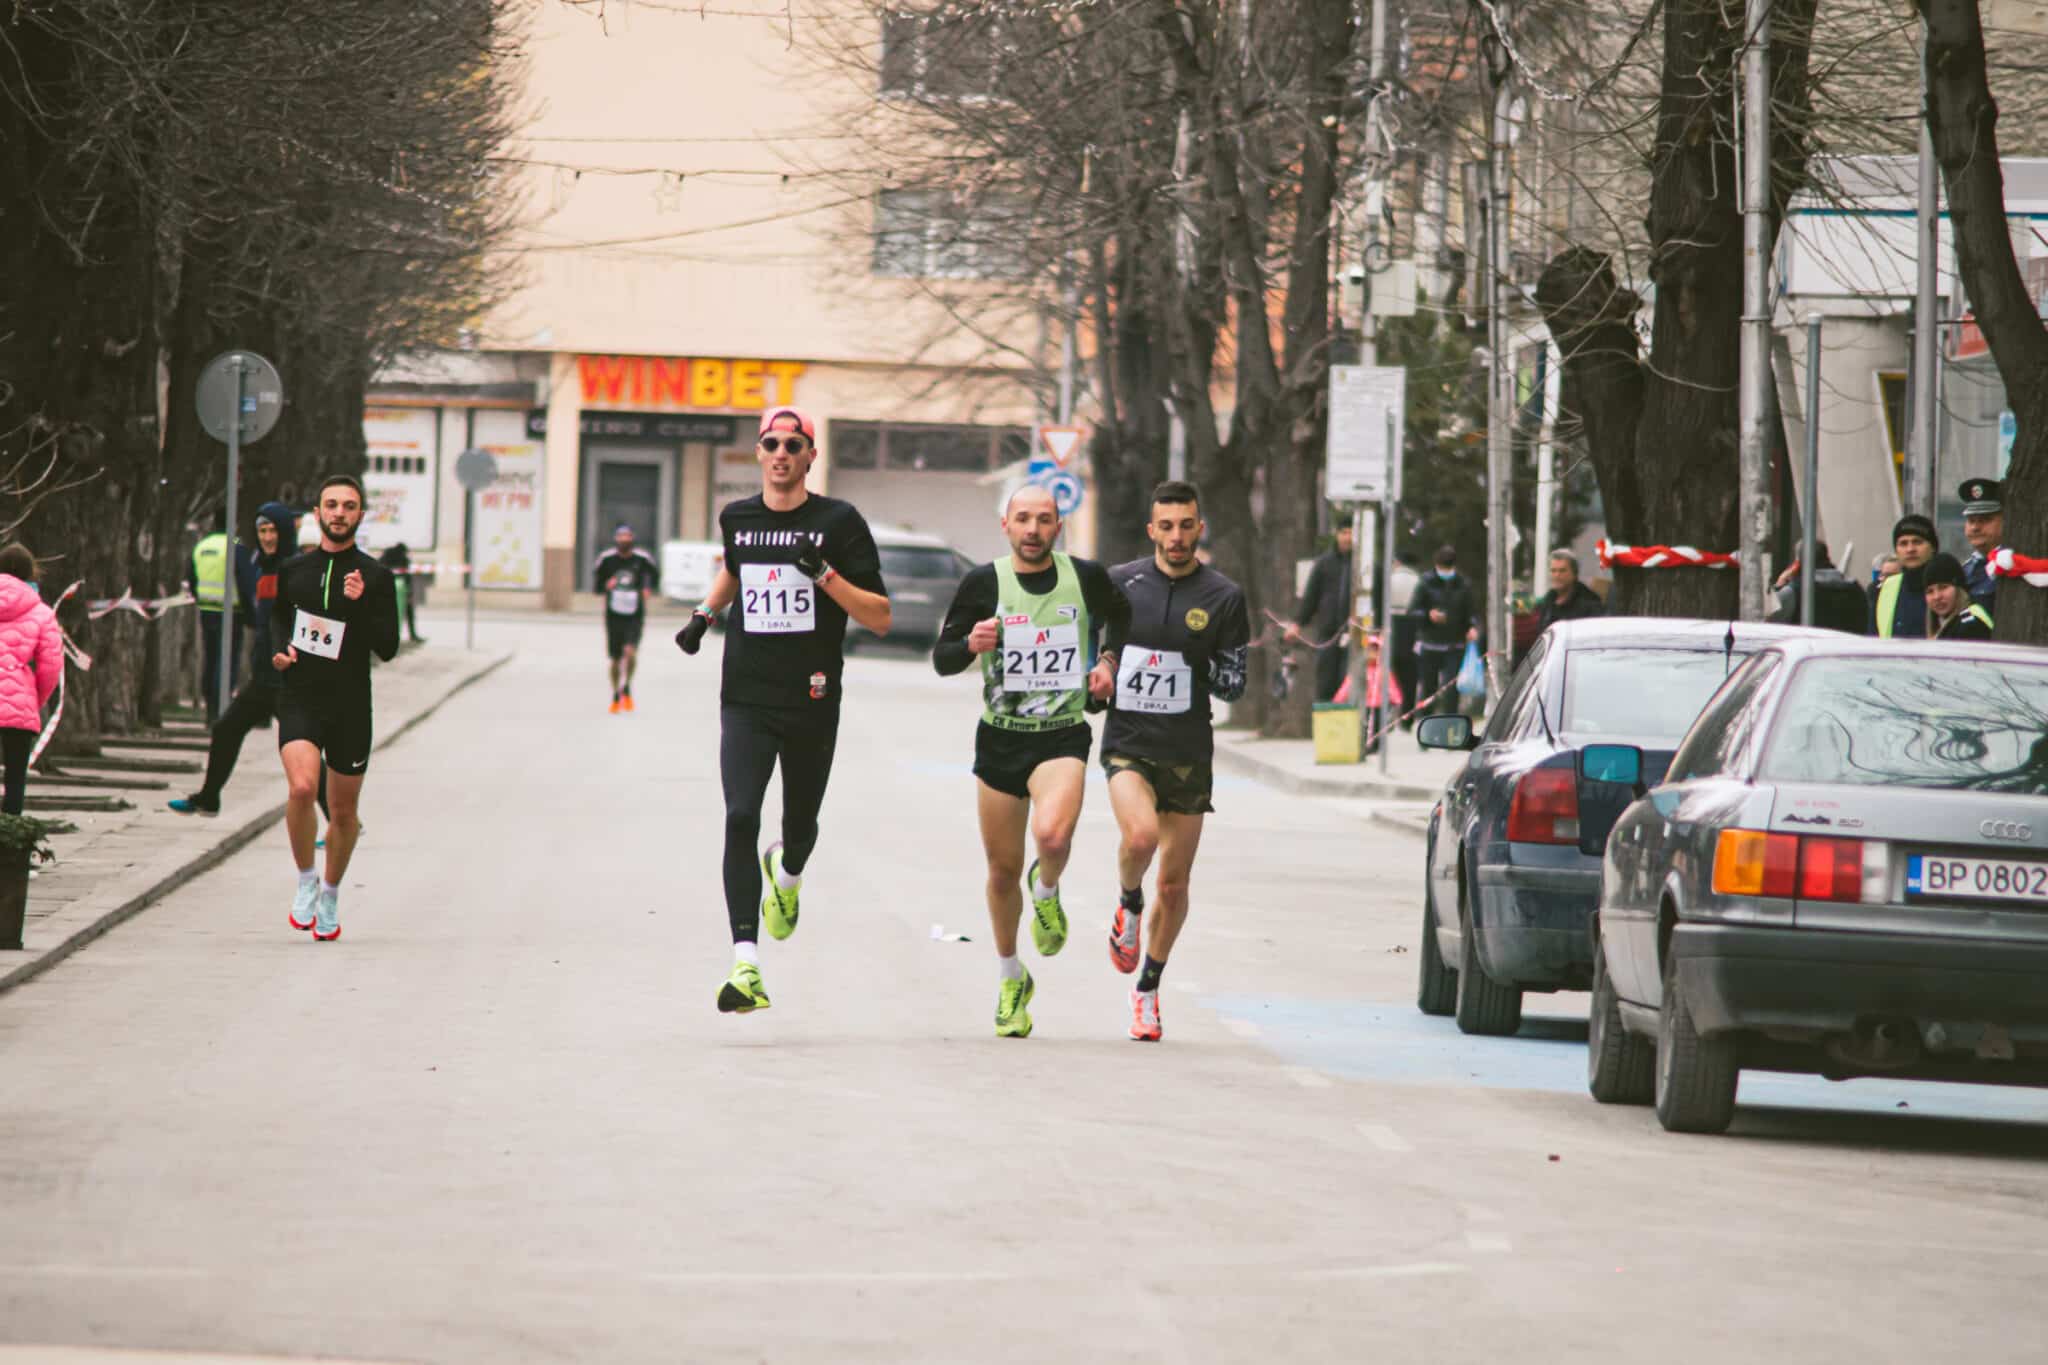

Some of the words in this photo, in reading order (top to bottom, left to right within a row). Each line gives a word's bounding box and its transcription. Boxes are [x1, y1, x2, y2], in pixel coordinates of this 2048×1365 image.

[577, 355, 807, 409] WINBET
[746, 589, 810, 614] 2115
[301, 626, 332, 646] 126
[1007, 647, 1077, 675] 2127
[1127, 671, 1177, 698] 471
[1928, 861, 1967, 891] BP
[1975, 864, 2048, 896] 0802
